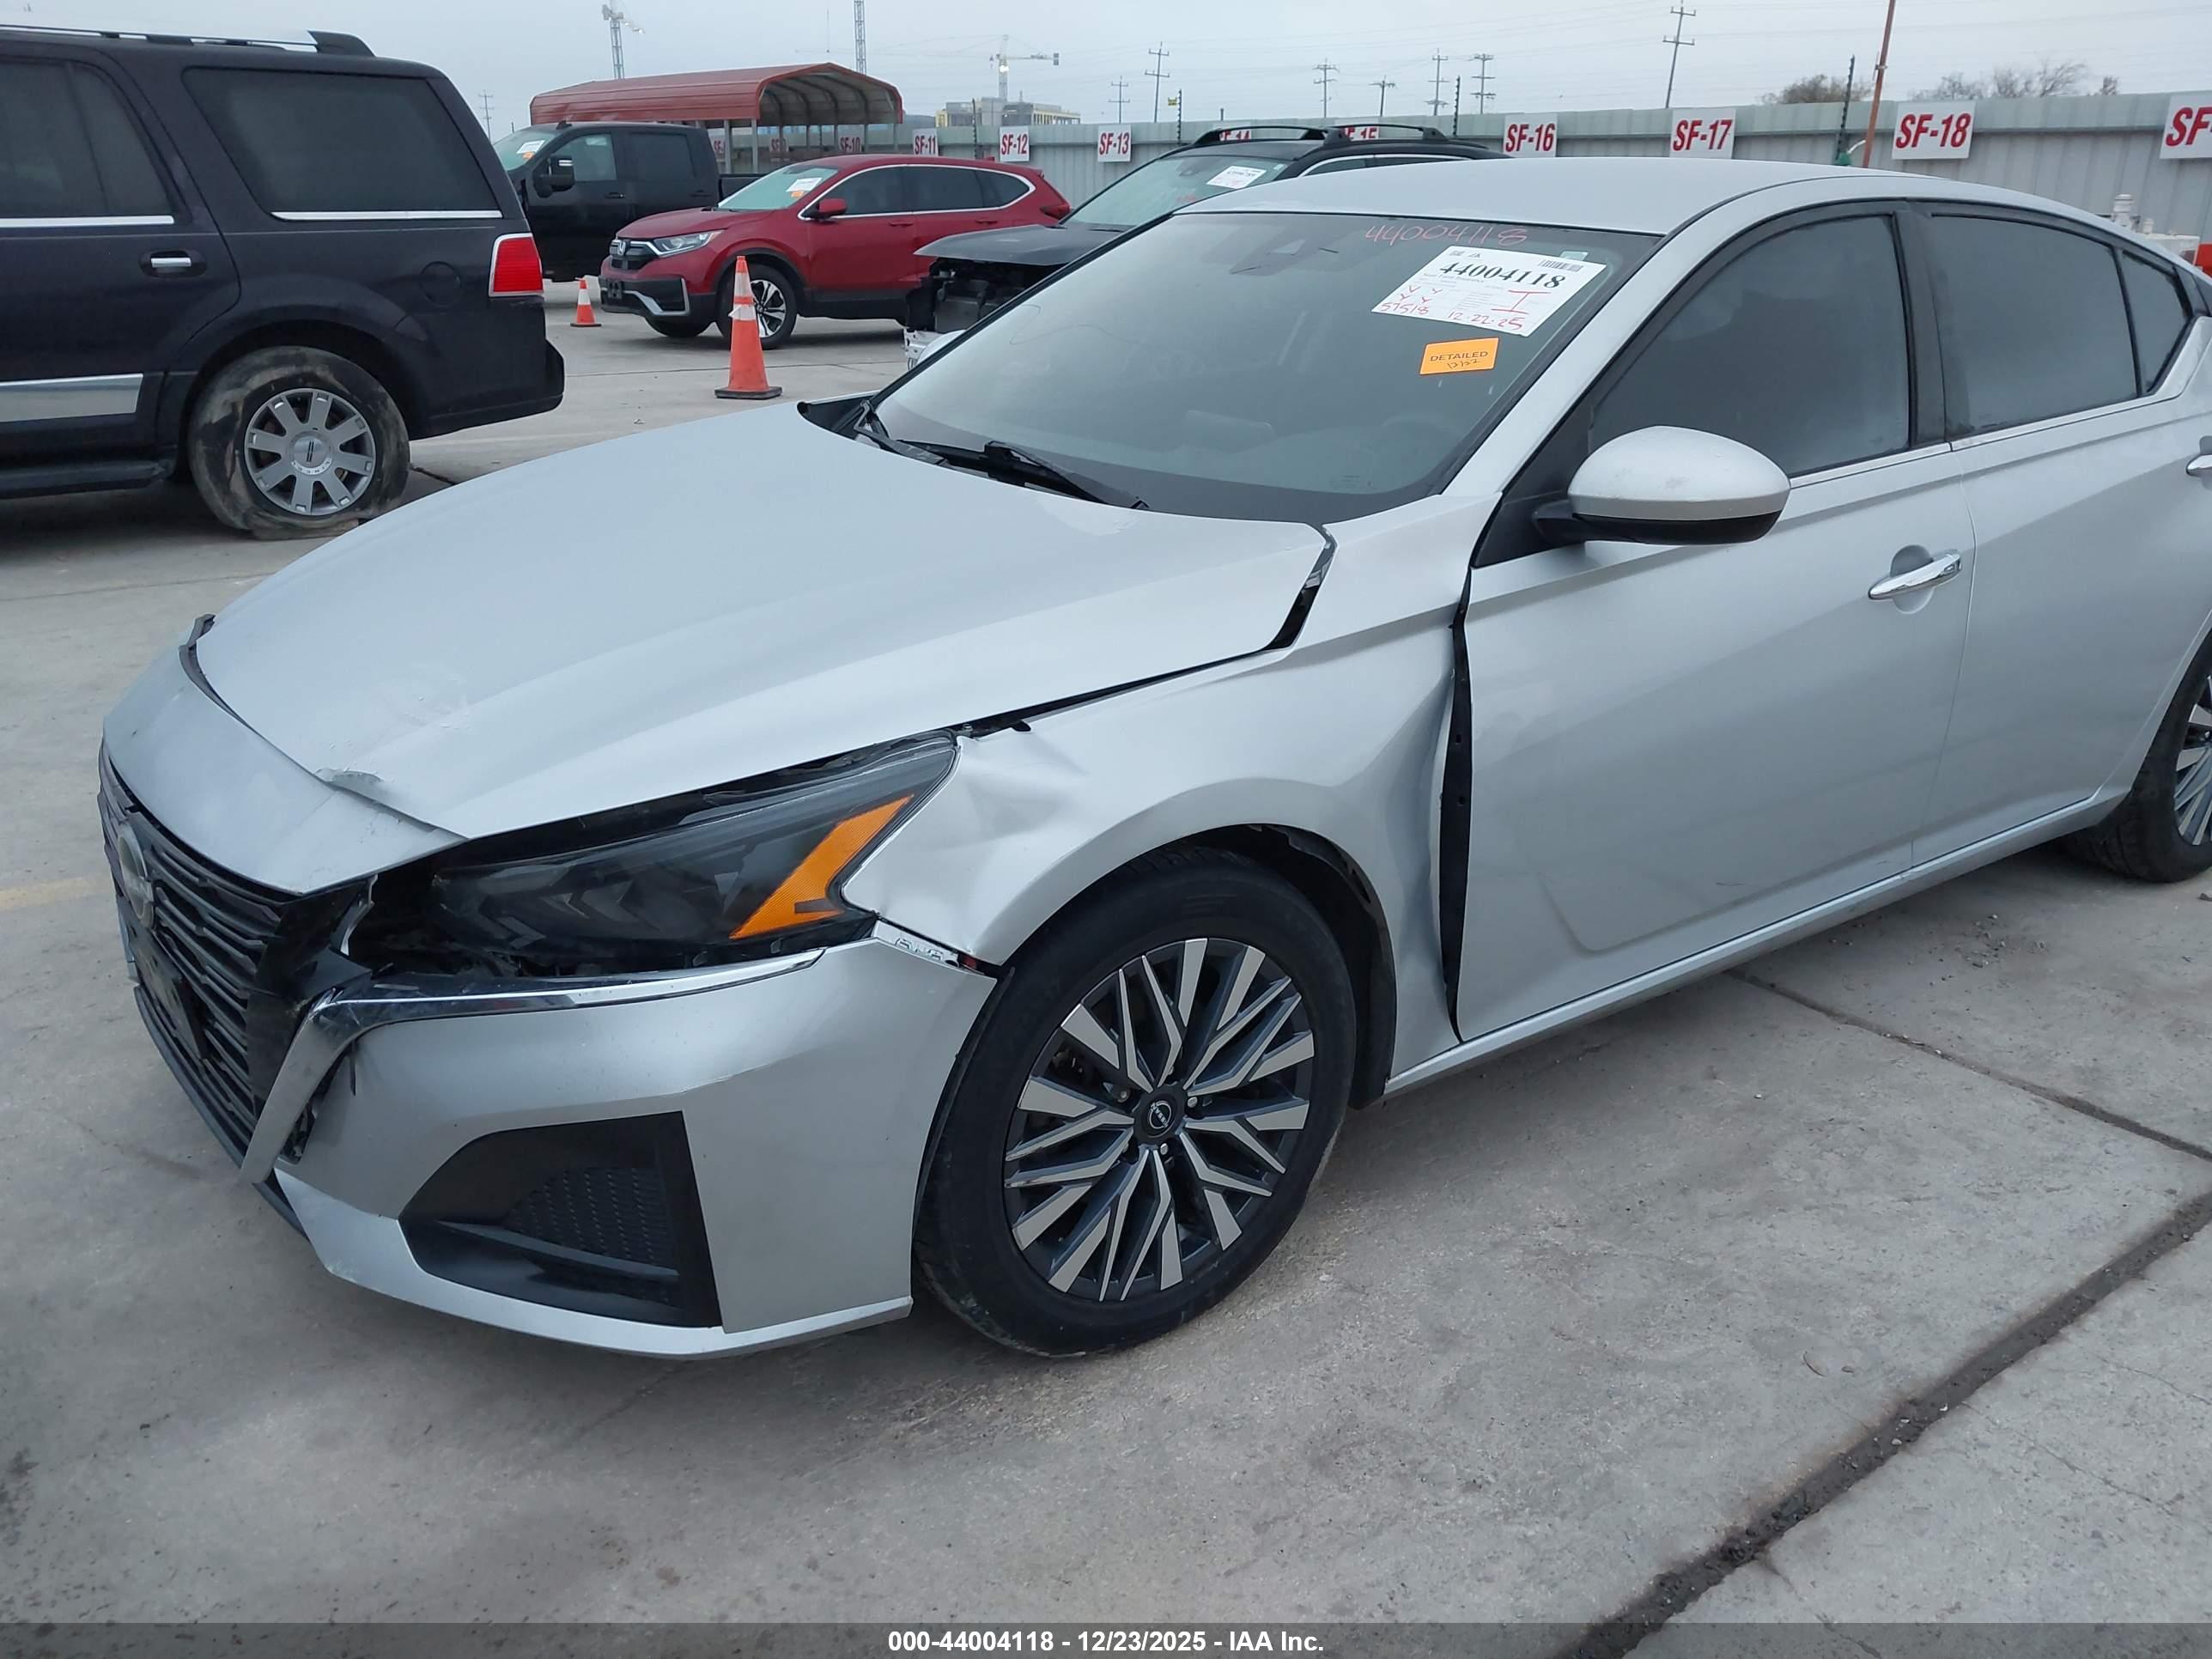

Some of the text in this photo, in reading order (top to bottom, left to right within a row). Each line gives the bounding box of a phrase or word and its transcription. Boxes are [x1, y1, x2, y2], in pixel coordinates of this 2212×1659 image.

[1505, 123, 1556, 152] SF-16
[1673, 118, 1733, 151] SF-17
[1895, 112, 1972, 149] SF-18
[2166, 106, 2212, 146] SF
[915, 135, 937, 155] SF-11
[1000, 133, 1028, 155] SF-12
[1098, 131, 1130, 155] SF-13
[1364, 223, 1528, 246] 44004118
[1439, 262, 1566, 289] 44004118
[1430, 350, 1488, 362] DETAILED
